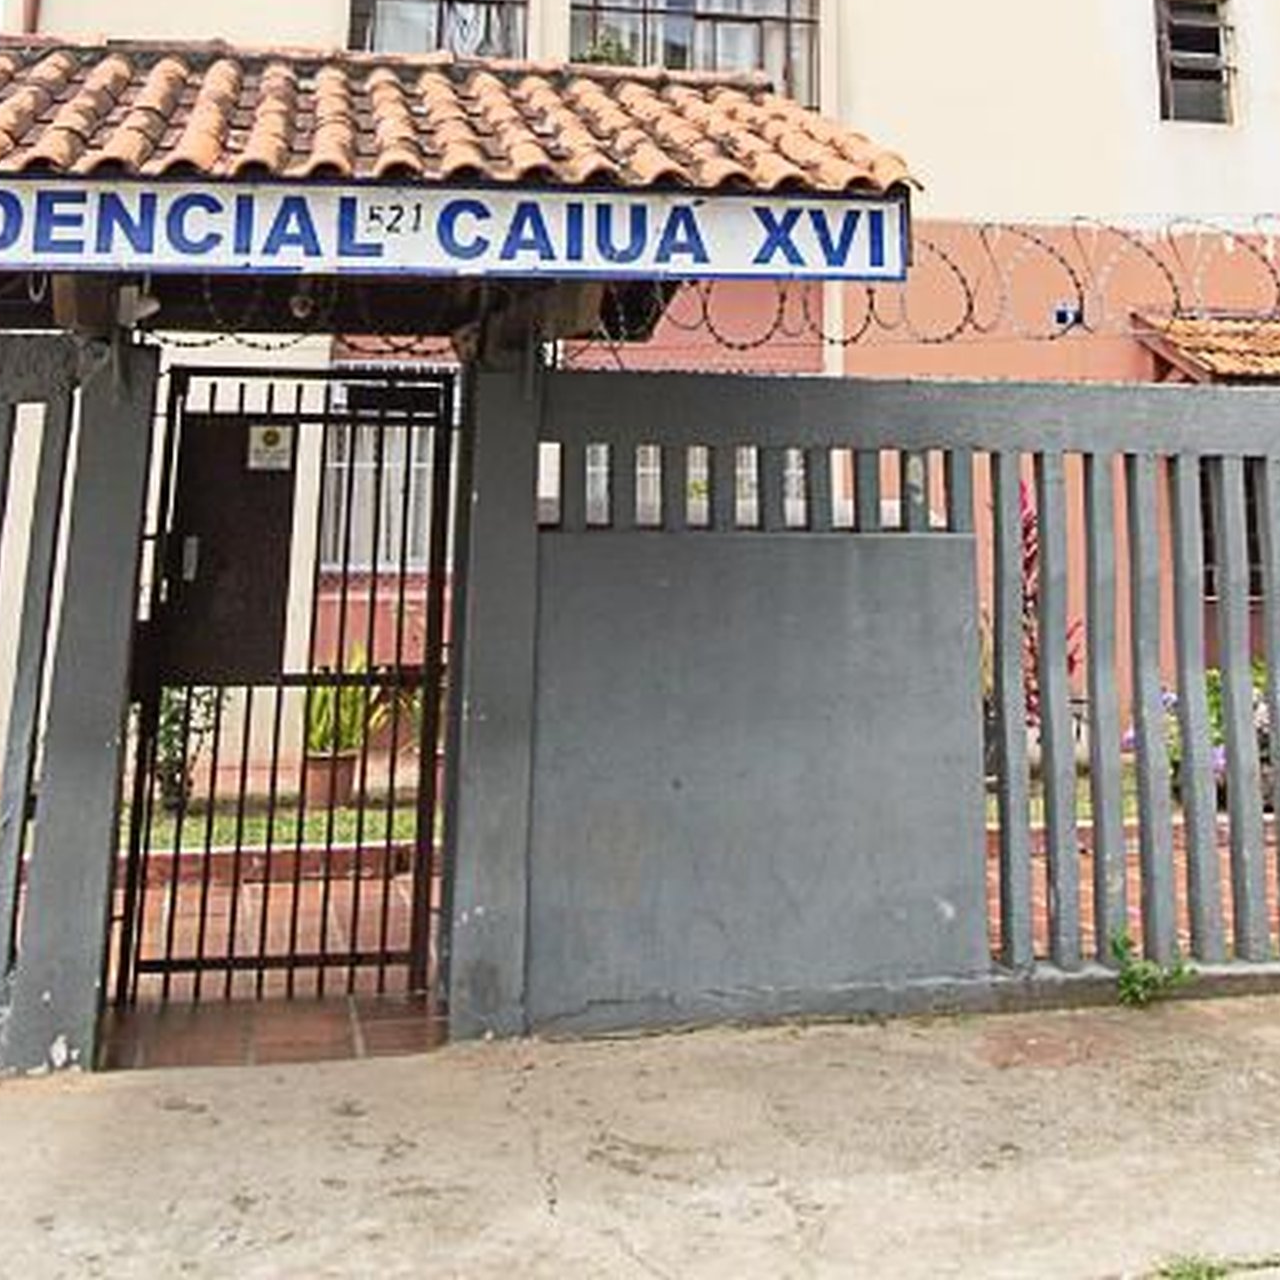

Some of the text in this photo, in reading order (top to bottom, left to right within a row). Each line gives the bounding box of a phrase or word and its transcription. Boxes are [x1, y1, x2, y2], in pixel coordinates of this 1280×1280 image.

[365, 202, 422, 233] 521
[436, 198, 711, 265] CAIUÁ
[752, 206, 885, 268] XVI
